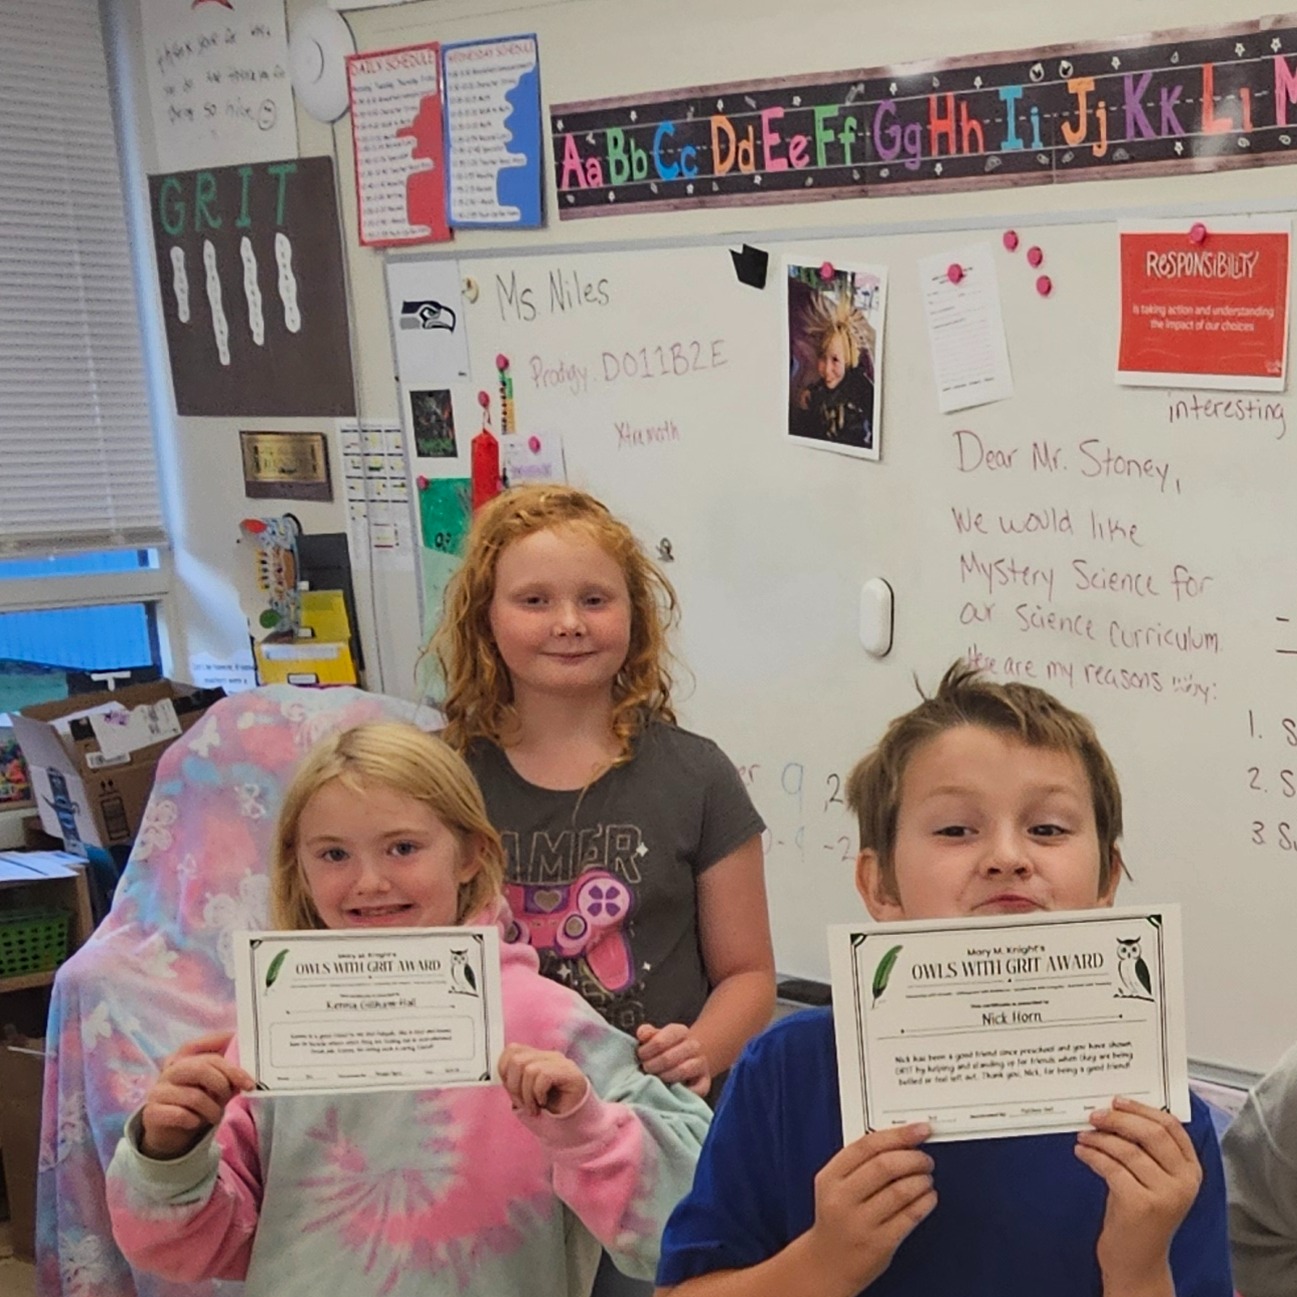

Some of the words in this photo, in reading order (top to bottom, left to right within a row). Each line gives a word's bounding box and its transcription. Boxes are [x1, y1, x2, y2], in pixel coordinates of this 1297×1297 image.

[561, 133, 603, 190] Aa
[606, 127, 648, 186] Bb
[652, 121, 698, 182] Cc
[710, 114, 755, 176] Dd
[761, 106, 810, 172] Ee
[814, 105, 858, 168] Ff
[873, 100, 922, 170] Gg
[929, 92, 985, 156] Hh
[999, 85, 1044, 151] Ii
[1061, 77, 1108, 157] Jj
[1124, 71, 1186, 141] Kk
[1203, 62, 1253, 136] Ll
[158, 163, 298, 236] GRIT
[496, 270, 536, 322] Ms
[549, 268, 610, 314] Niles
[1140, 303, 1167, 318] taking
[1168, 304, 1194, 316] action
[1194, 304, 1212, 316] and
[1212, 305, 1275, 320] understanding
[1150, 319, 1164, 330] the
[1165, 319, 1194, 332] impact
[1195, 319, 1205, 331] of
[1205, 321, 1221, 331] our
[1221, 320, 1255, 332] choices
[1168, 391, 1288, 440] interesting
[952, 429, 1018, 473] Dear
[1032, 441, 1068, 472] Mr.
[951, 507, 988, 535] We
[999, 509, 1073, 536] would
[1091, 510, 1145, 547] like
[960, 551, 1055, 602] Mystery
[1071, 558, 1161, 598] Science
[1171, 564, 1215, 602] for
[1003, 656, 1038, 679] are
[1046, 662, 1075, 689] my
[1084, 663, 1164, 693] reasons
[1248, 766, 1268, 793] 2.
[295, 960, 331, 975] OWLS
[333, 961, 364, 974] WITH
[367, 960, 393, 973] GRIT
[398, 959, 441, 973] AWARD
[911, 961, 958, 980] OWLS
[961, 959, 1002, 978] WITH
[1006, 956, 1041, 975] GRIT
[1046, 951, 1104, 973] AWARD
[966, 946, 991, 958] Mary
[1006, 943, 1046, 955] Knight's
[982, 1012, 1008, 1026] Nick
